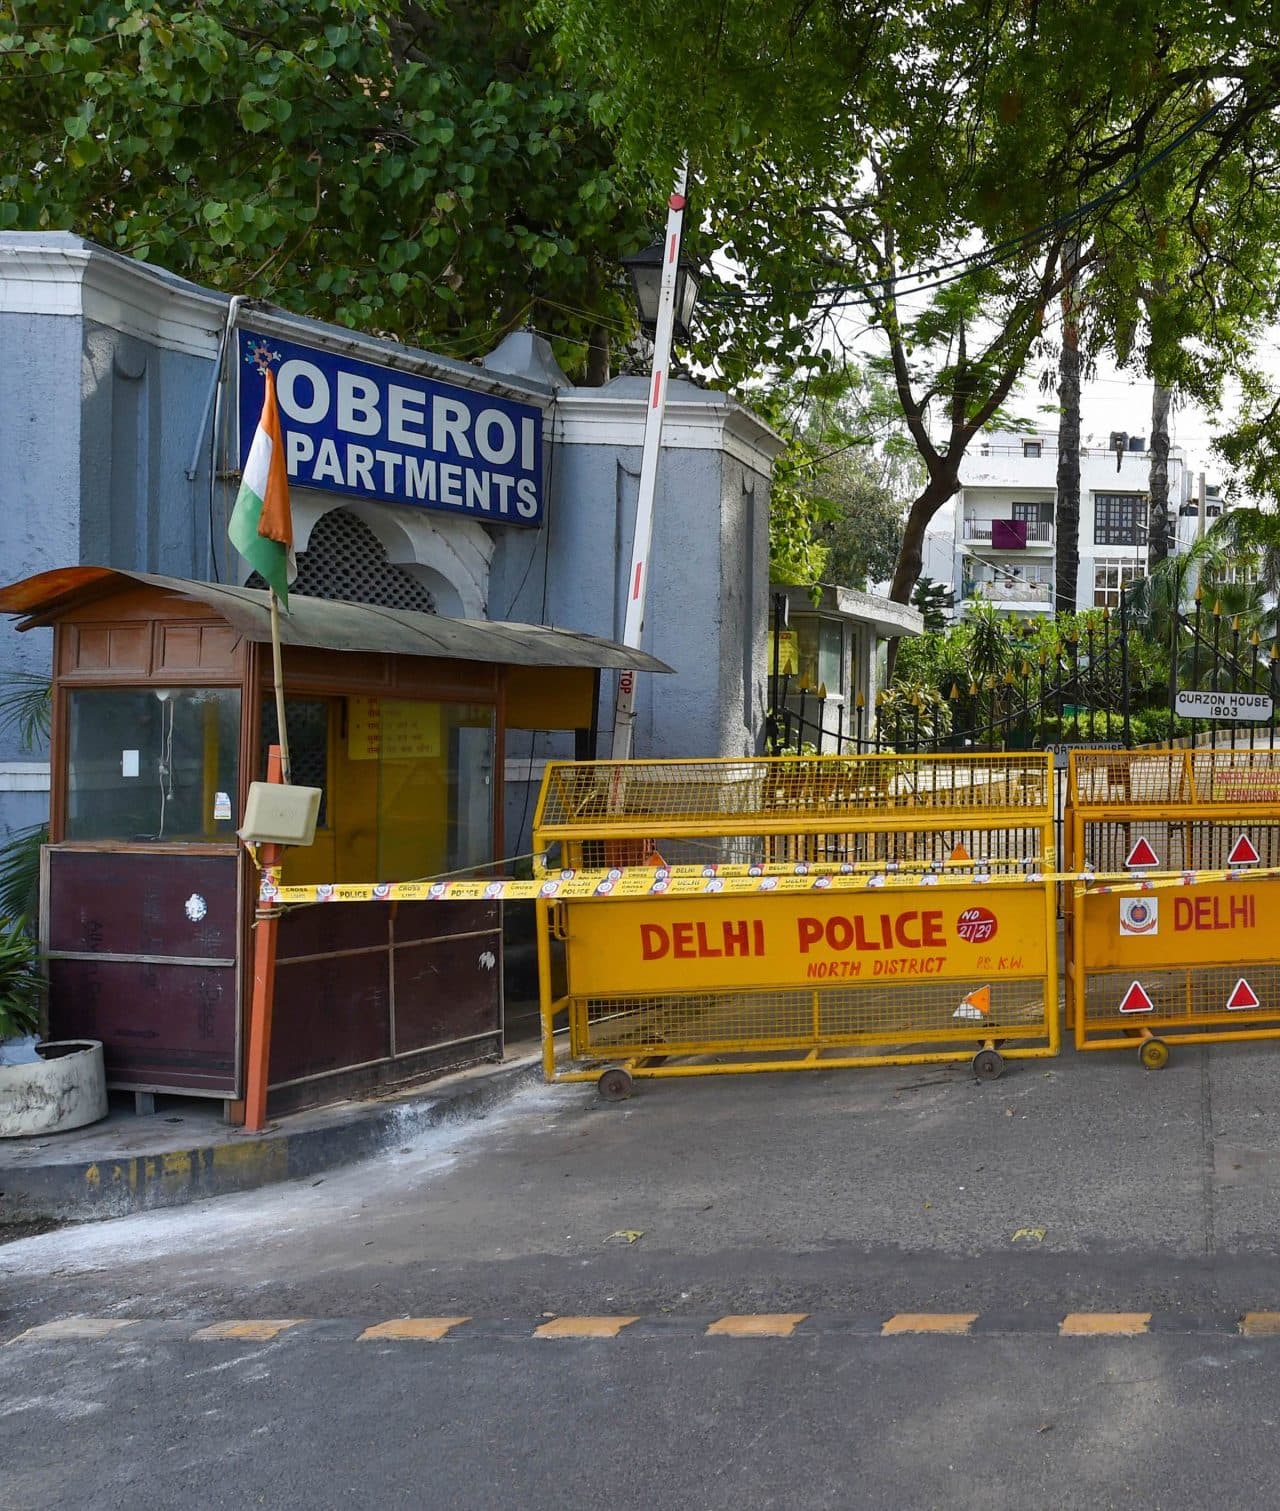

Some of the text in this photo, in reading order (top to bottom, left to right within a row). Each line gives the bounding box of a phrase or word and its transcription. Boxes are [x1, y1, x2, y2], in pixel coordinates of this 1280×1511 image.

[276, 359, 535, 471] OBEROI
[287, 431, 538, 518] PARTMENTS
[620, 671, 632, 694] TOP
[1179, 693, 1270, 707] CURZON HOUSE
[1210, 706, 1238, 717] 1903
[339, 891, 368, 899] POLICE
[1173, 894, 1256, 932] DELHI
[640, 910, 947, 961] DELHI POLICE
[807, 956, 947, 978] NORTH DISTRICT
